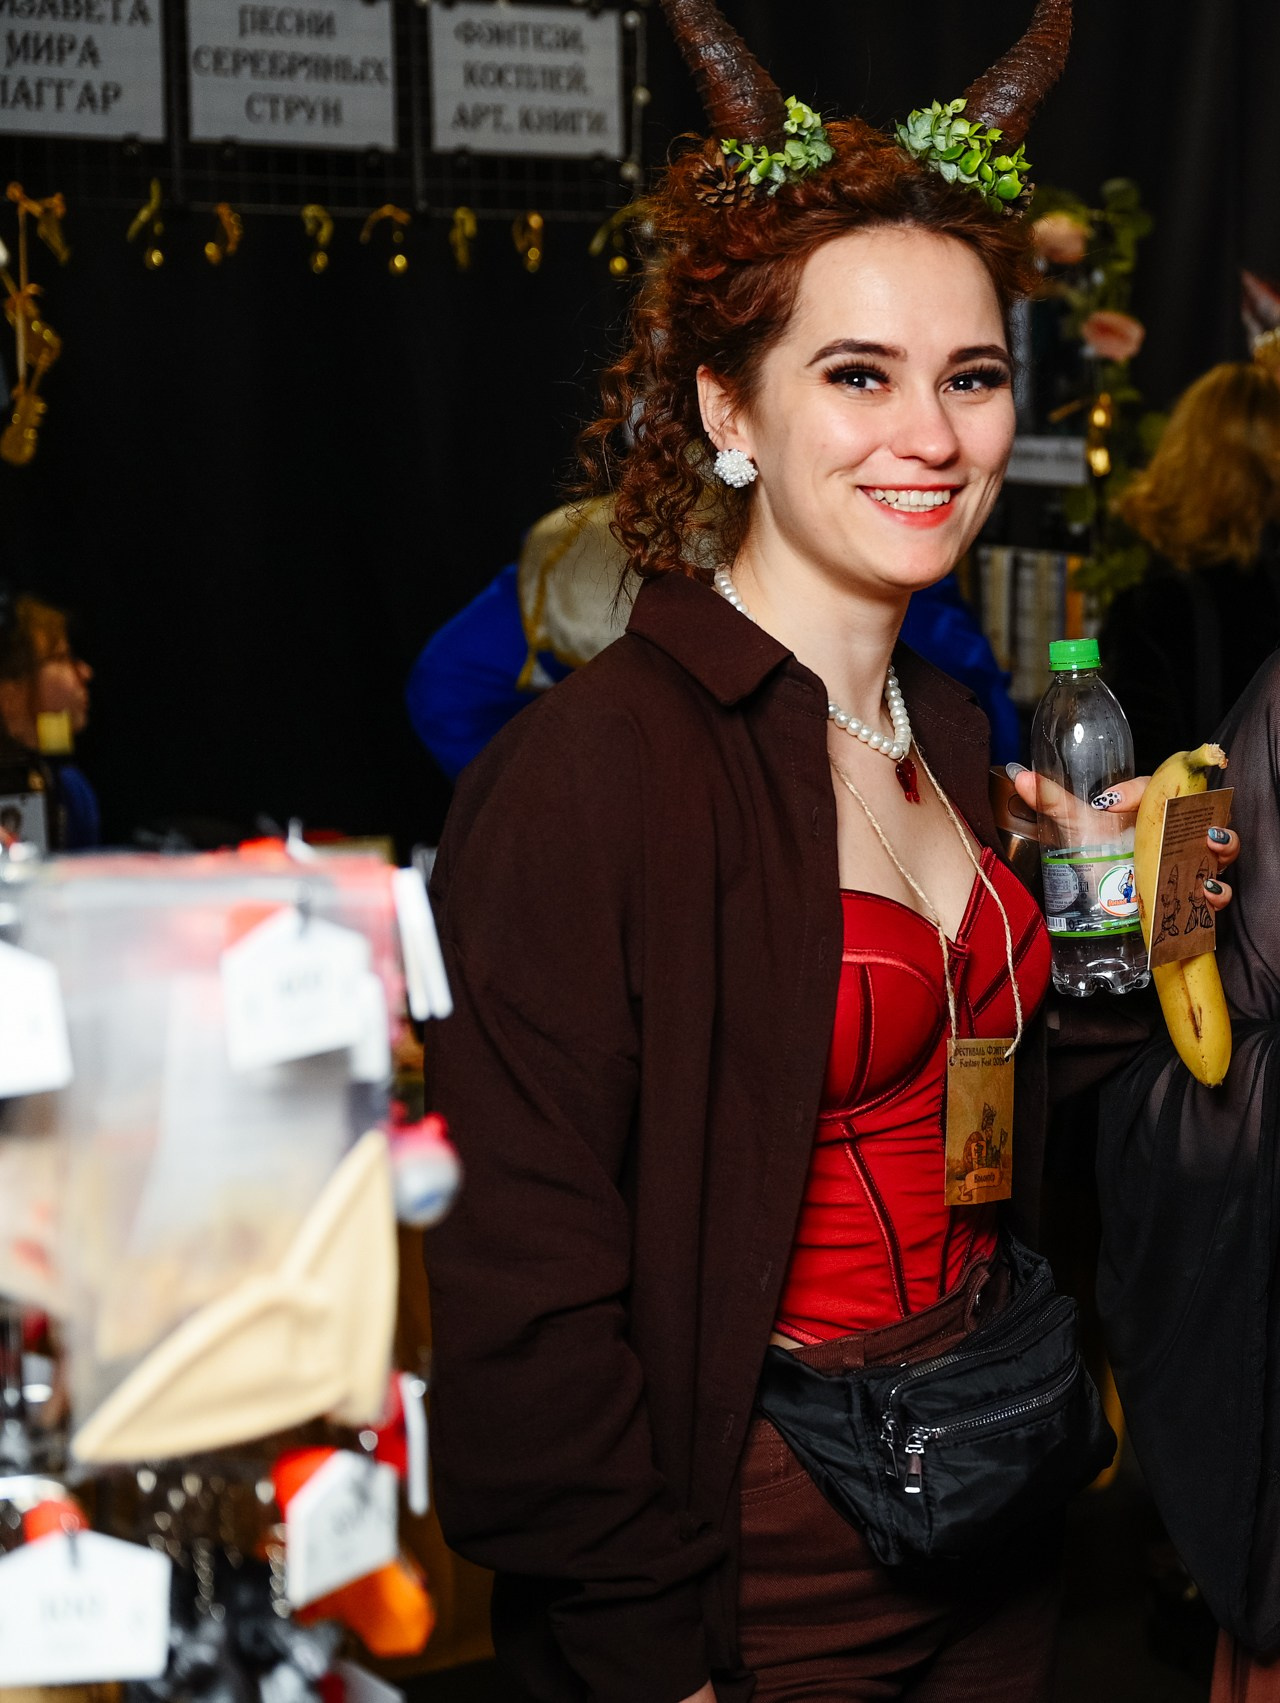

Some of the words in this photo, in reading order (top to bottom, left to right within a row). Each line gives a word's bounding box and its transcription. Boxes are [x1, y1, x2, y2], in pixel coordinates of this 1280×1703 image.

[5, 29, 101, 68] МИРА
[193, 44, 388, 86] СЕРЕБРЯНЫХ
[245, 92, 344, 128] СТРУН
[518, 104, 608, 137] КНИГИ
